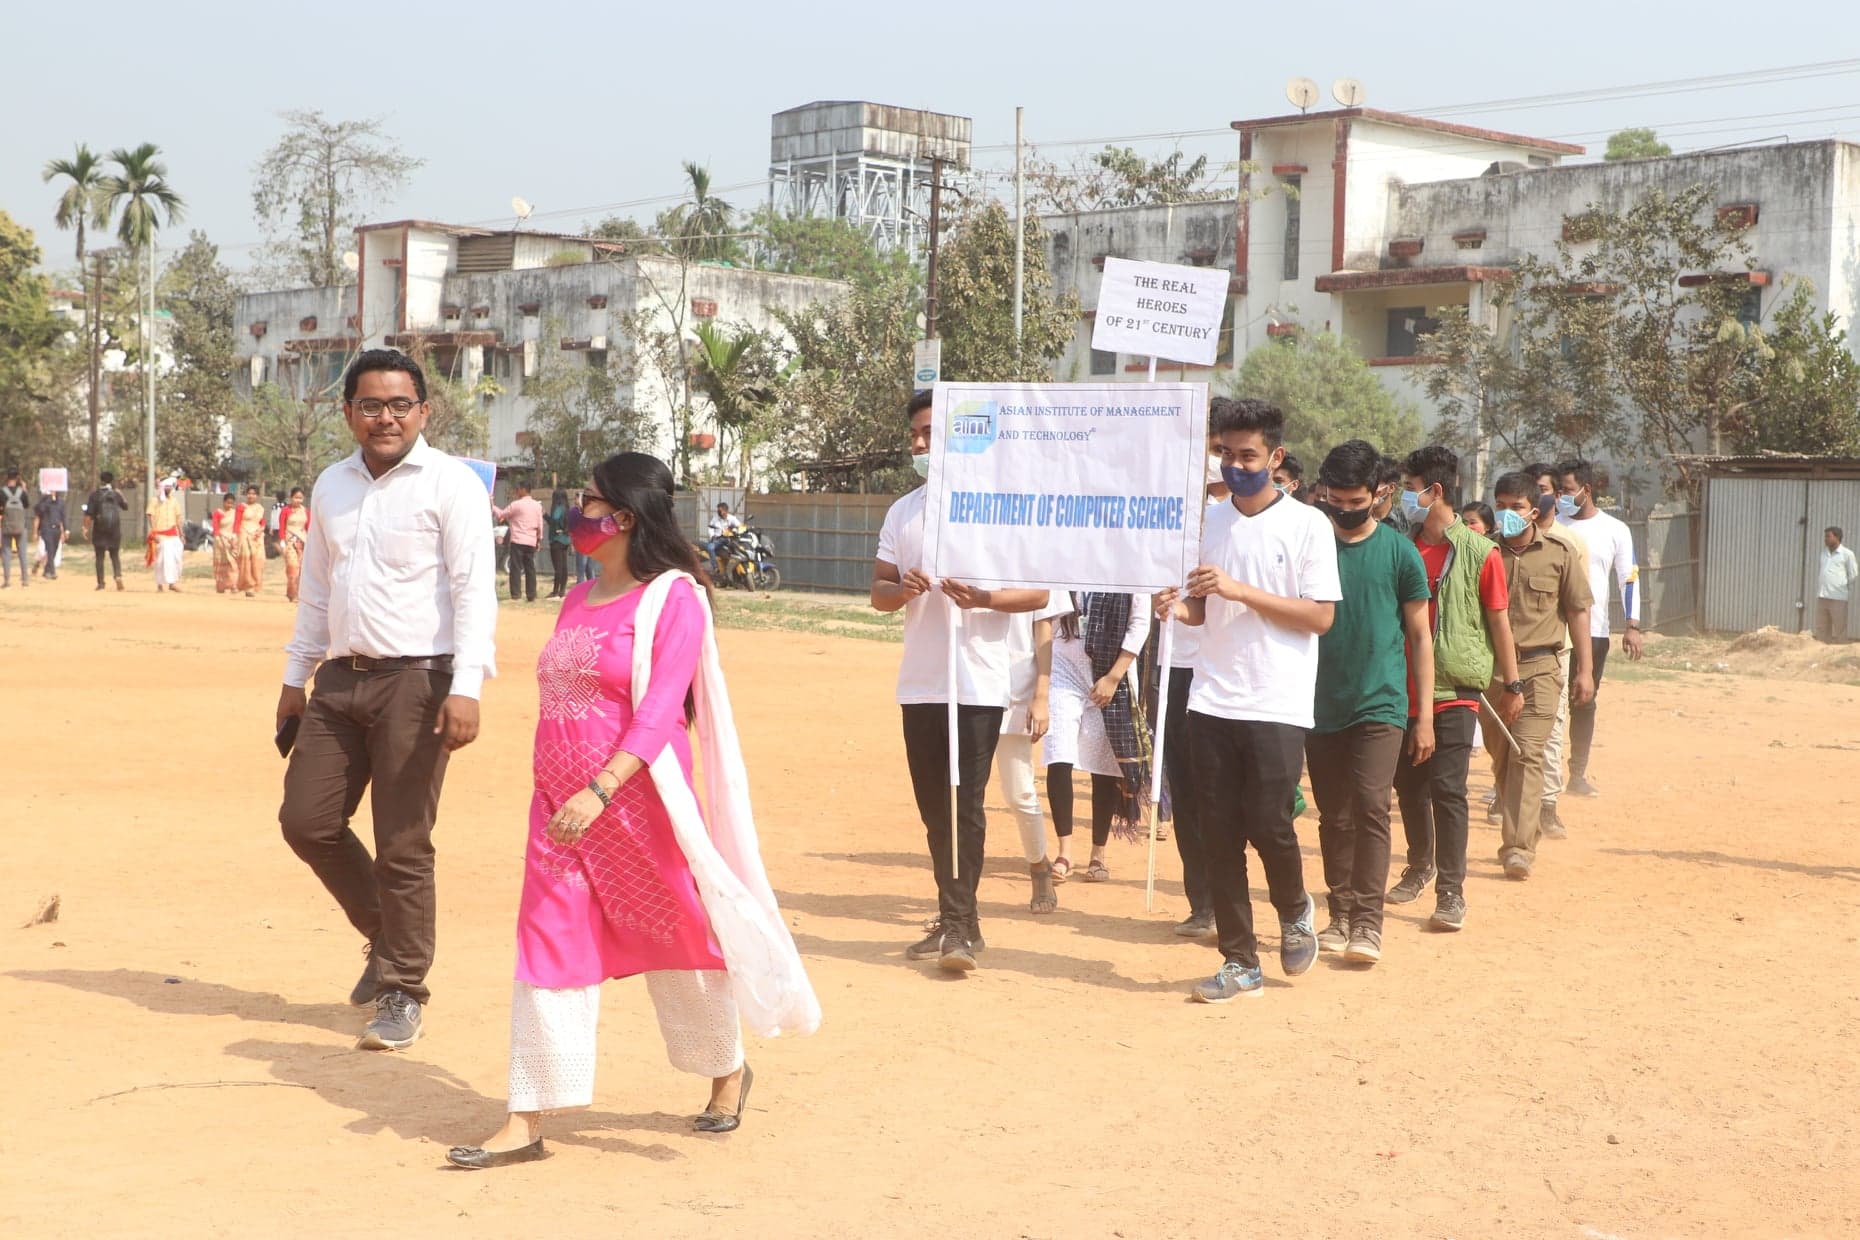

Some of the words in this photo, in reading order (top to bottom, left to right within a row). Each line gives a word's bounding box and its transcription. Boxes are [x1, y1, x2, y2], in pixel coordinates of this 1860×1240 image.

[1134, 276, 1158, 289] THE
[1162, 280, 1197, 294] REAL
[1137, 297, 1187, 314] HEROES
[1106, 315, 1123, 327] OF
[1152, 321, 1212, 339] CENTURY
[1000, 405, 1034, 416] ASIAN
[1035, 406, 1087, 416] INSTITUTE
[1090, 406, 1104, 416] OF
[1106, 406, 1182, 416] MANAGEMENT
[998, 430, 1020, 440] AND
[949, 491, 1036, 526] DEPARTMENT
[1037, 494, 1054, 527] OF
[1055, 494, 1126, 528] COMPUTER
[1127, 496, 1184, 530] SCIENCE
